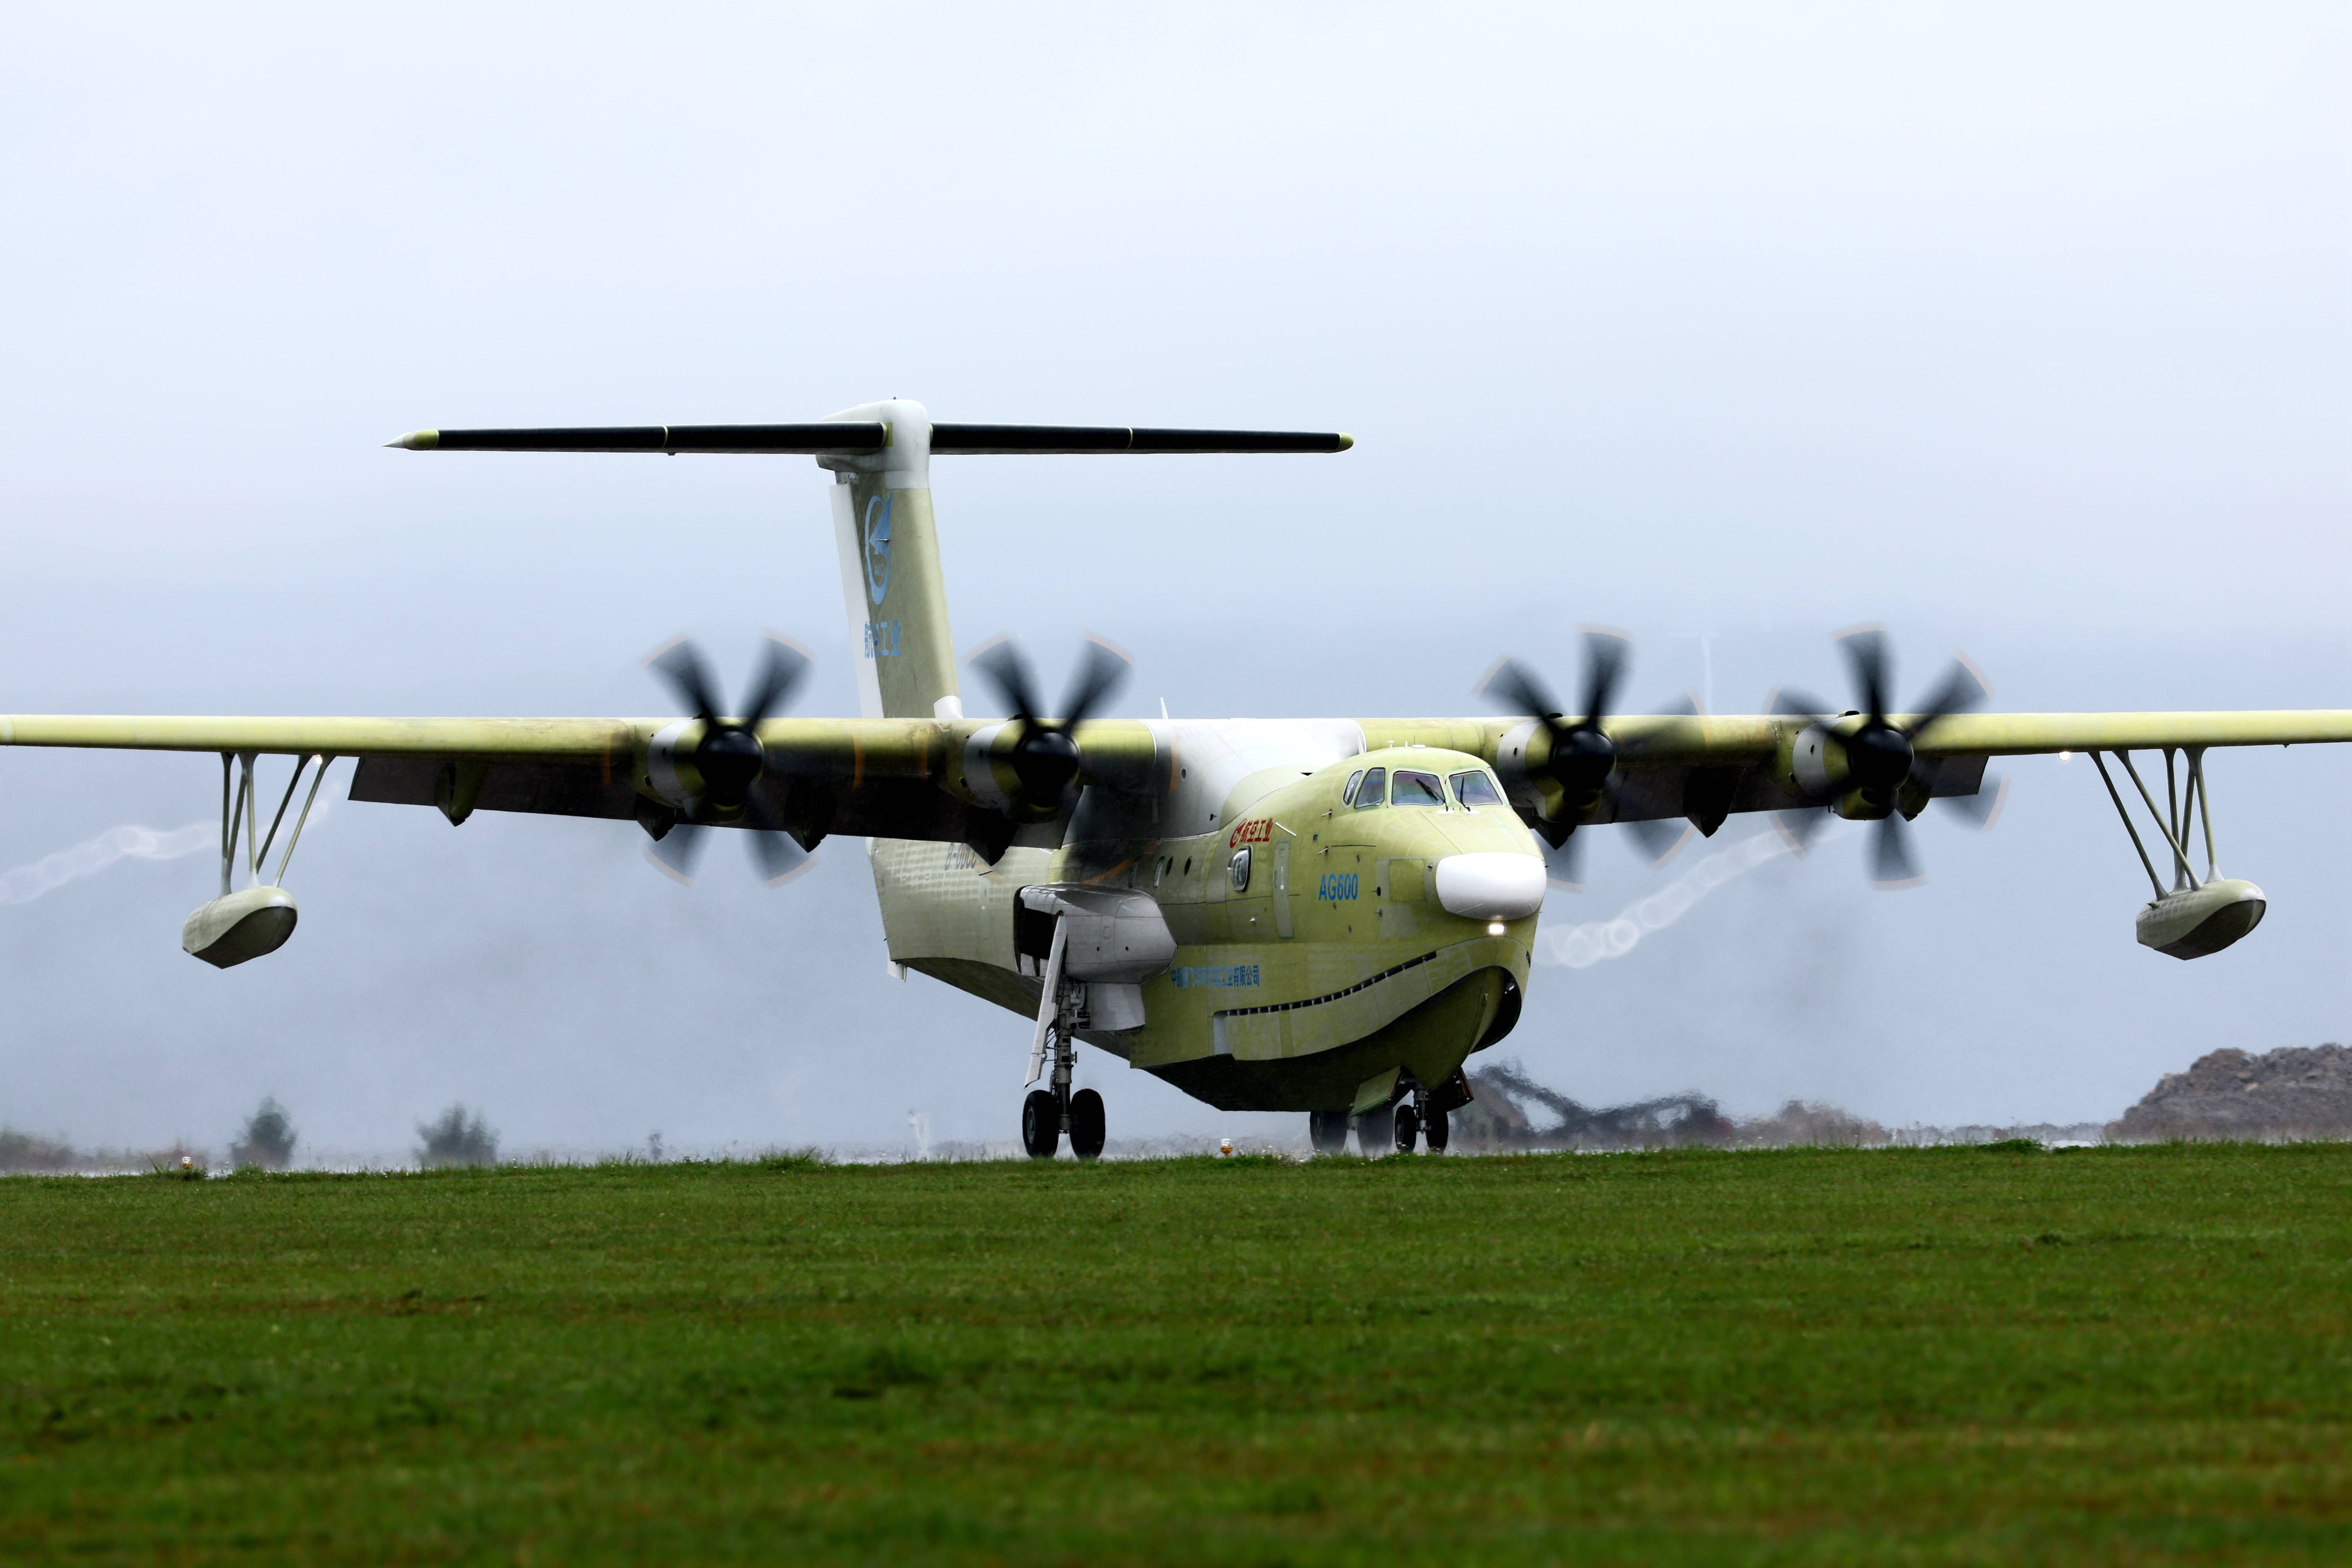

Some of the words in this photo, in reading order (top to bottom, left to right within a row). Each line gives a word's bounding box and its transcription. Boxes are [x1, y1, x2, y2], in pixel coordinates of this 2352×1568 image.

[1240, 818, 1273, 842] 航空工业
[1319, 873, 1359, 900] AG600
